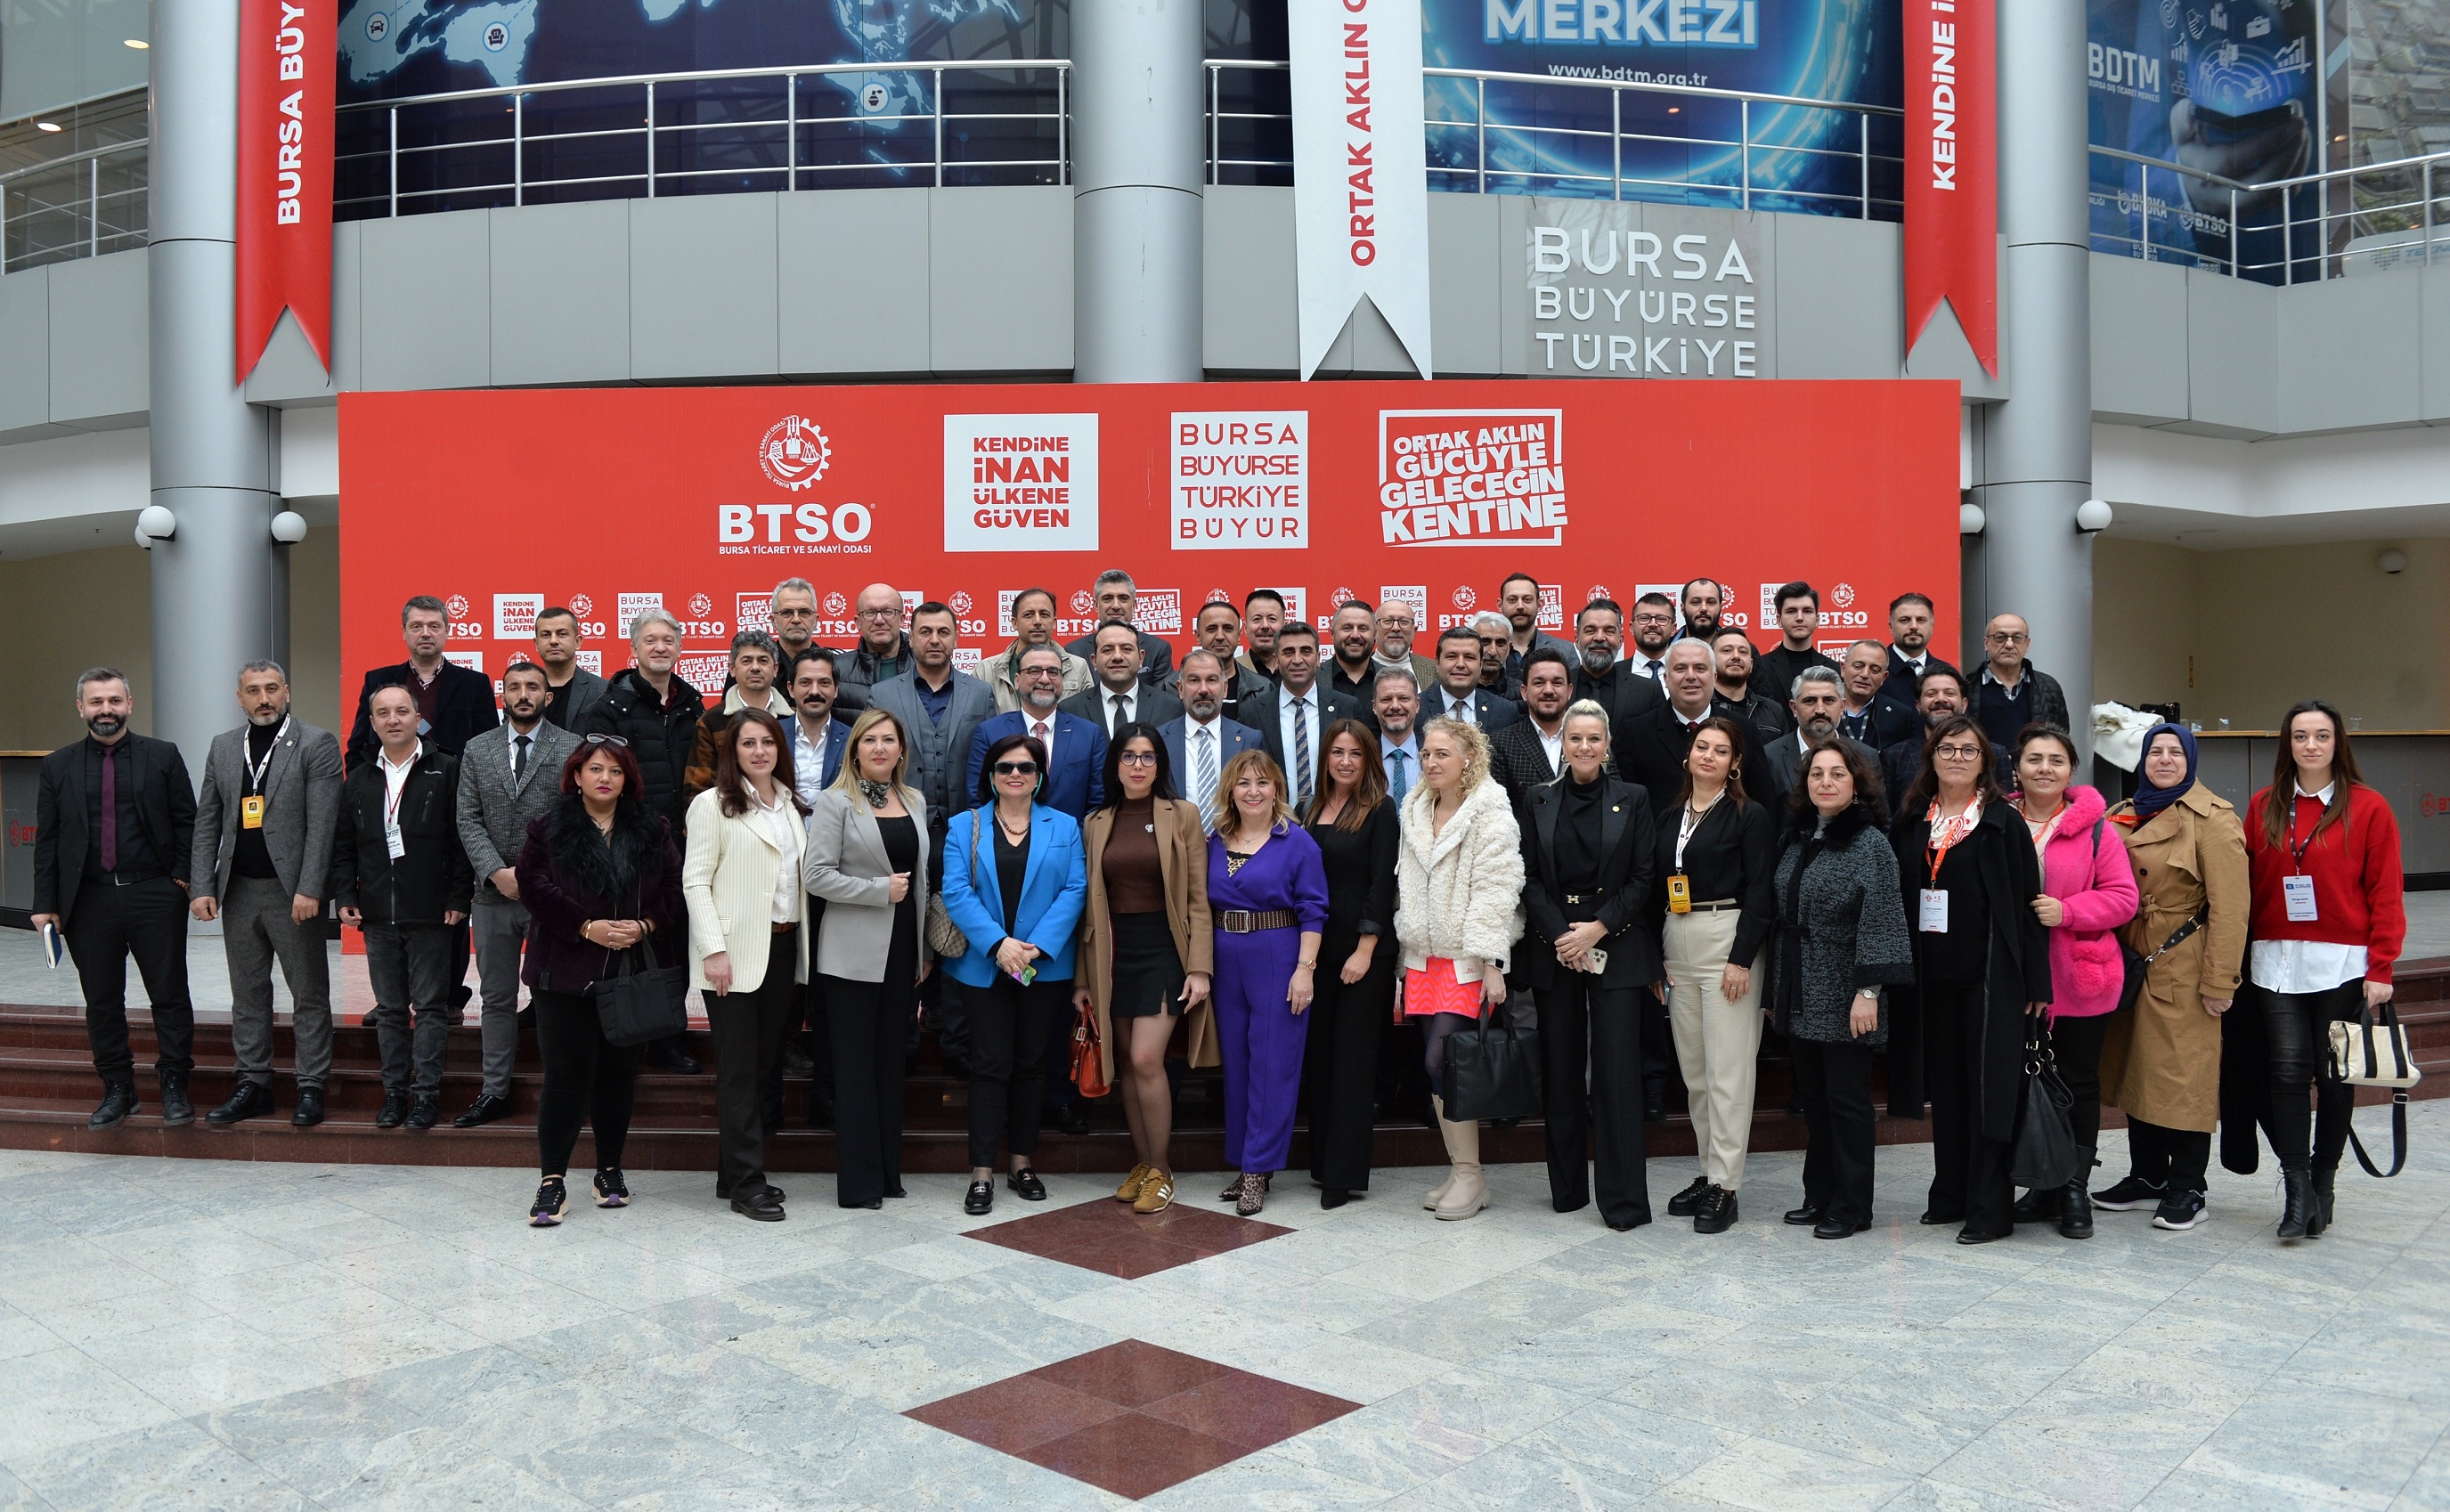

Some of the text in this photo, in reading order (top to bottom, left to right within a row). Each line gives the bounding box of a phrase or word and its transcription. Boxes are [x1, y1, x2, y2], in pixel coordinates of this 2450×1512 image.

[1549, 63, 1707, 86] www.bdtm.org.tr
[2088, 42, 2160, 93] BDTM
[1344, 23, 1372, 133] AKLIN
[276, 1, 305, 224] BURSA BÜY
[1347, 141, 1376, 266] ORTAK
[1534, 226, 1754, 283] BURSA
[1535, 286, 1755, 329] BÜYÜRSE
[1180, 423, 1298, 445] BURSA
[1394, 423, 1545, 454] ORTAK AKLIN
[1180, 455, 1298, 476] BÜYÜRSE
[1396, 442, 1547, 479] GÜCÜYLE
[974, 488, 1069, 504] ÜLKENE
[720, 503, 871, 542] BTSO
[973, 508, 1069, 528] GÜVEN
[1180, 517, 1298, 539] BÜYÜR
[720, 543, 872, 554] BURSA TİCARET VE SANAYİ ODASI
[1383, 589, 1423, 597] BURSA
[621, 597, 659, 605] BURSA
[741, 599, 767, 607] ORTAK
[1134, 600, 1175, 612] ÜCÜYLE
[737, 614, 772, 625] GELEC
[1130, 617, 1182, 631] ENTİNE
[1439, 614, 1473, 627] BTS
[1720, 613, 1747, 626] SO
[1819, 611, 1868, 624] BTSO
[448, 622, 482, 636] TSO
[578, 622, 606, 636] SO
[956, 620, 986, 633] SO
[1822, 647, 1848, 655] ORTAK
[680, 657, 704, 665] ORTAK
